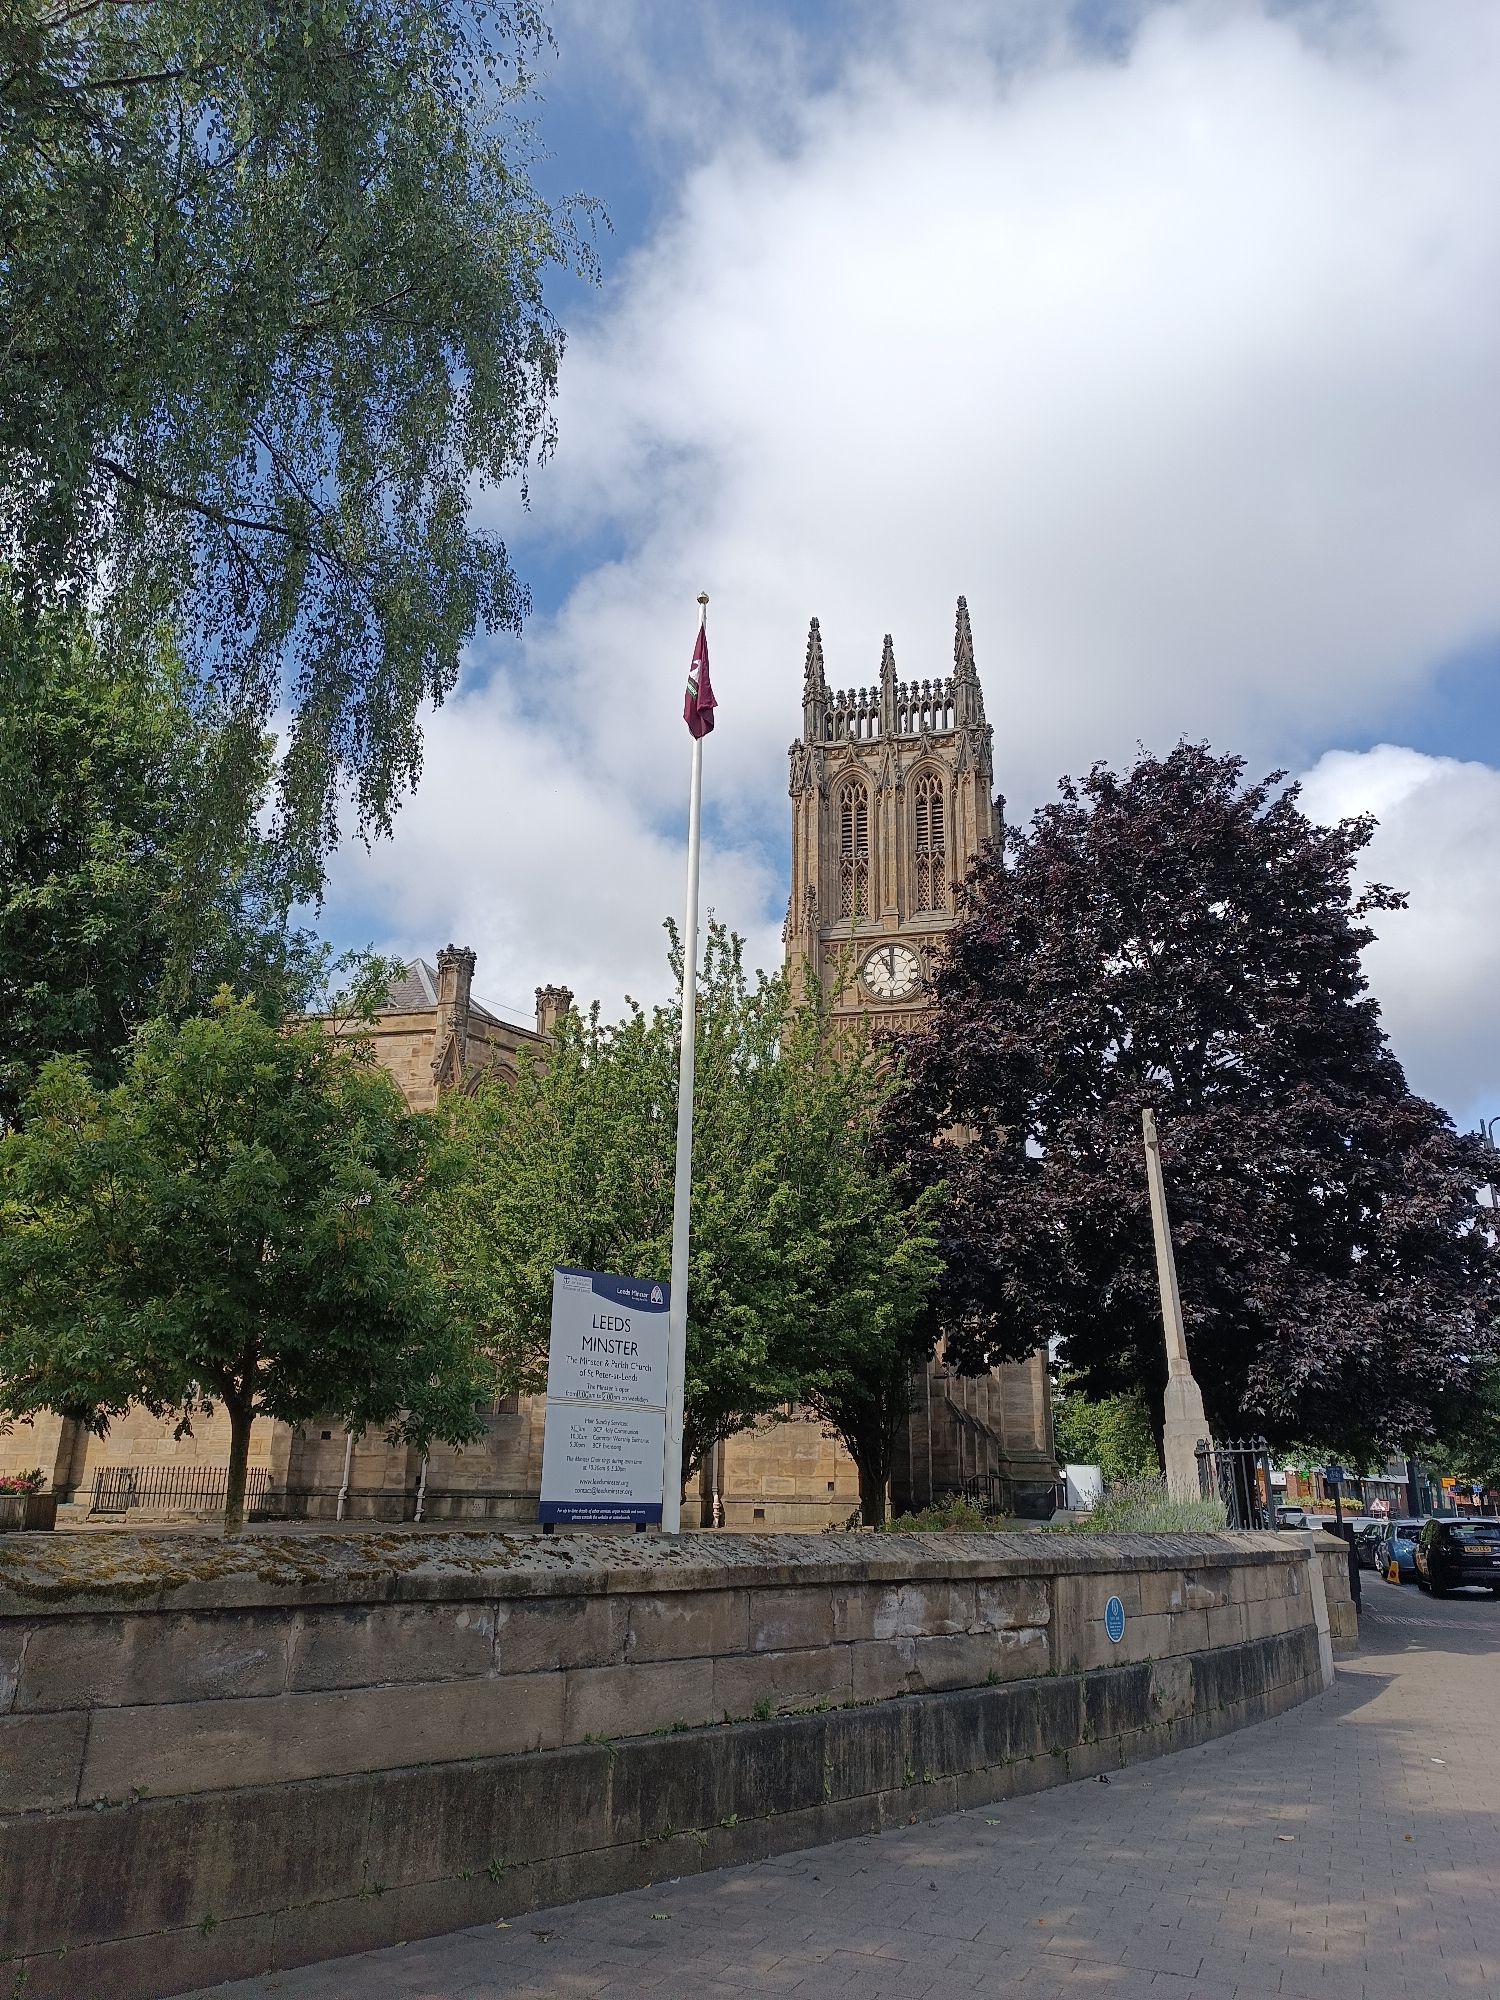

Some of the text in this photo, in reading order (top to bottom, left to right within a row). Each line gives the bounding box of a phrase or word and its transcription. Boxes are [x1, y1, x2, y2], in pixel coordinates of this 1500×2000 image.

[592, 1314, 631, 1332] LEEDS
[582, 1336, 638, 1356] MINSTER
[566, 1354, 652, 1372] The Minster & Parish Church
